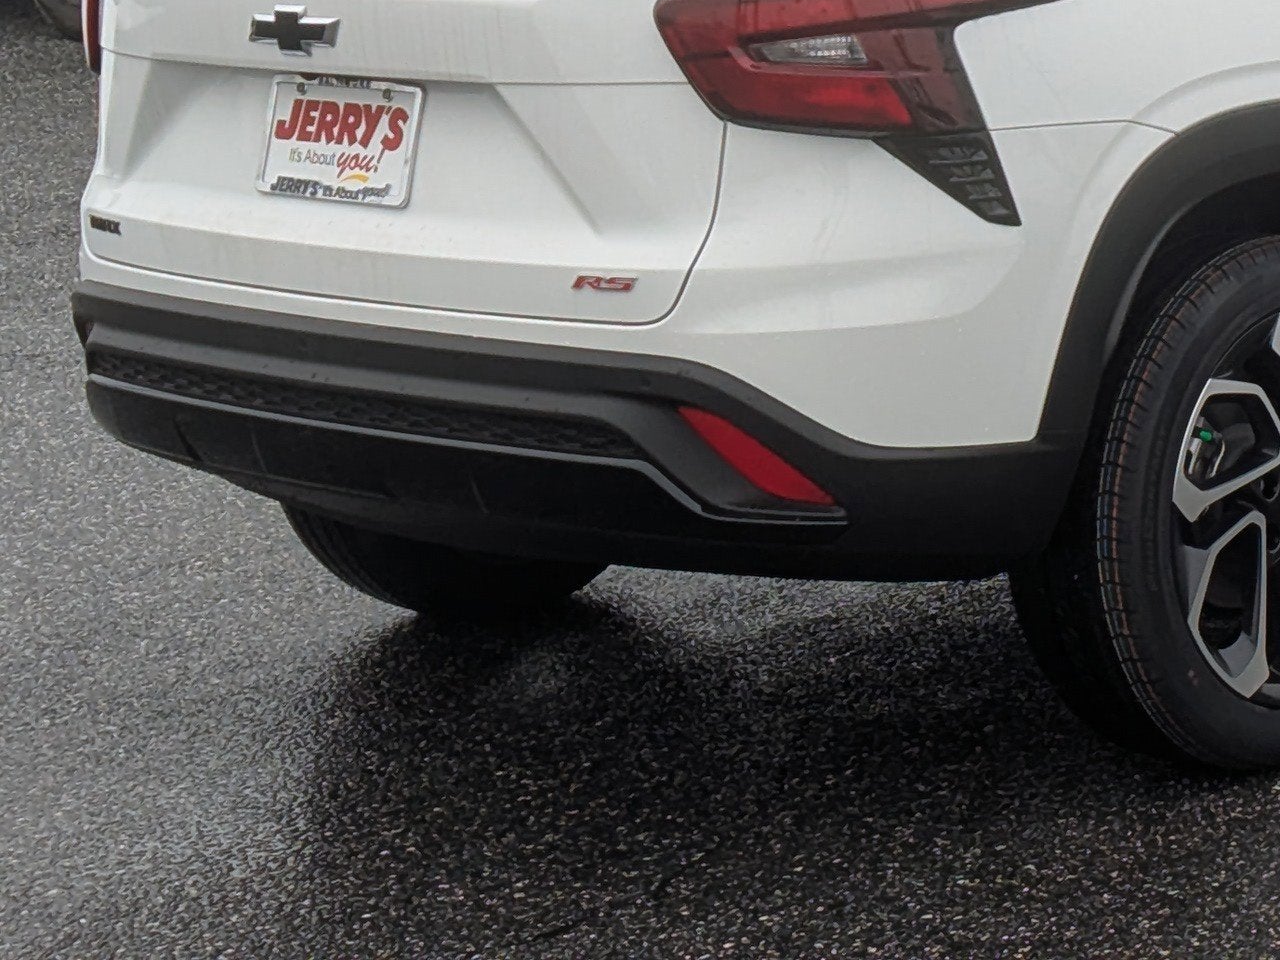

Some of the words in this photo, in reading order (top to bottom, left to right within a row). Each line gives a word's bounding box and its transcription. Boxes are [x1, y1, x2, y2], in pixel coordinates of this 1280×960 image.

[274, 98, 410, 151] JERRY'S
[289, 147, 301, 163] It's
[304, 149, 336, 166] About
[571, 275, 639, 292] RS
